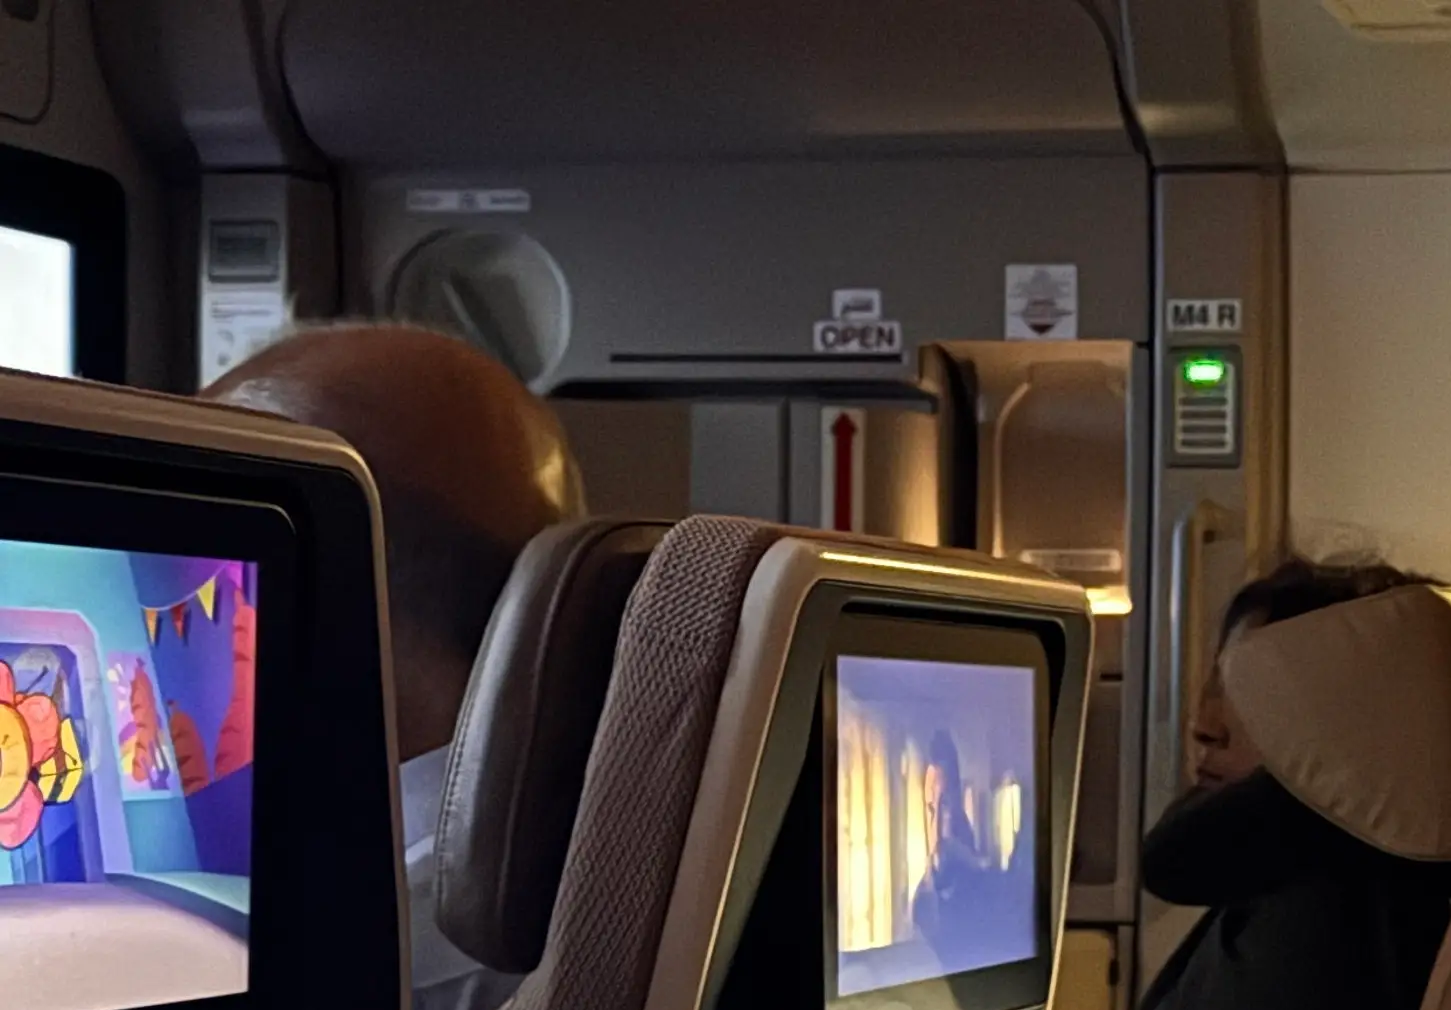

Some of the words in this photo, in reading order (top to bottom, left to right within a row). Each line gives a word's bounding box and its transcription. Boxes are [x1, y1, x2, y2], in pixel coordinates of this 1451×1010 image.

[1173, 303, 1210, 328] M4
[1217, 303, 1237, 329] R
[820, 324, 896, 349] OPEN
